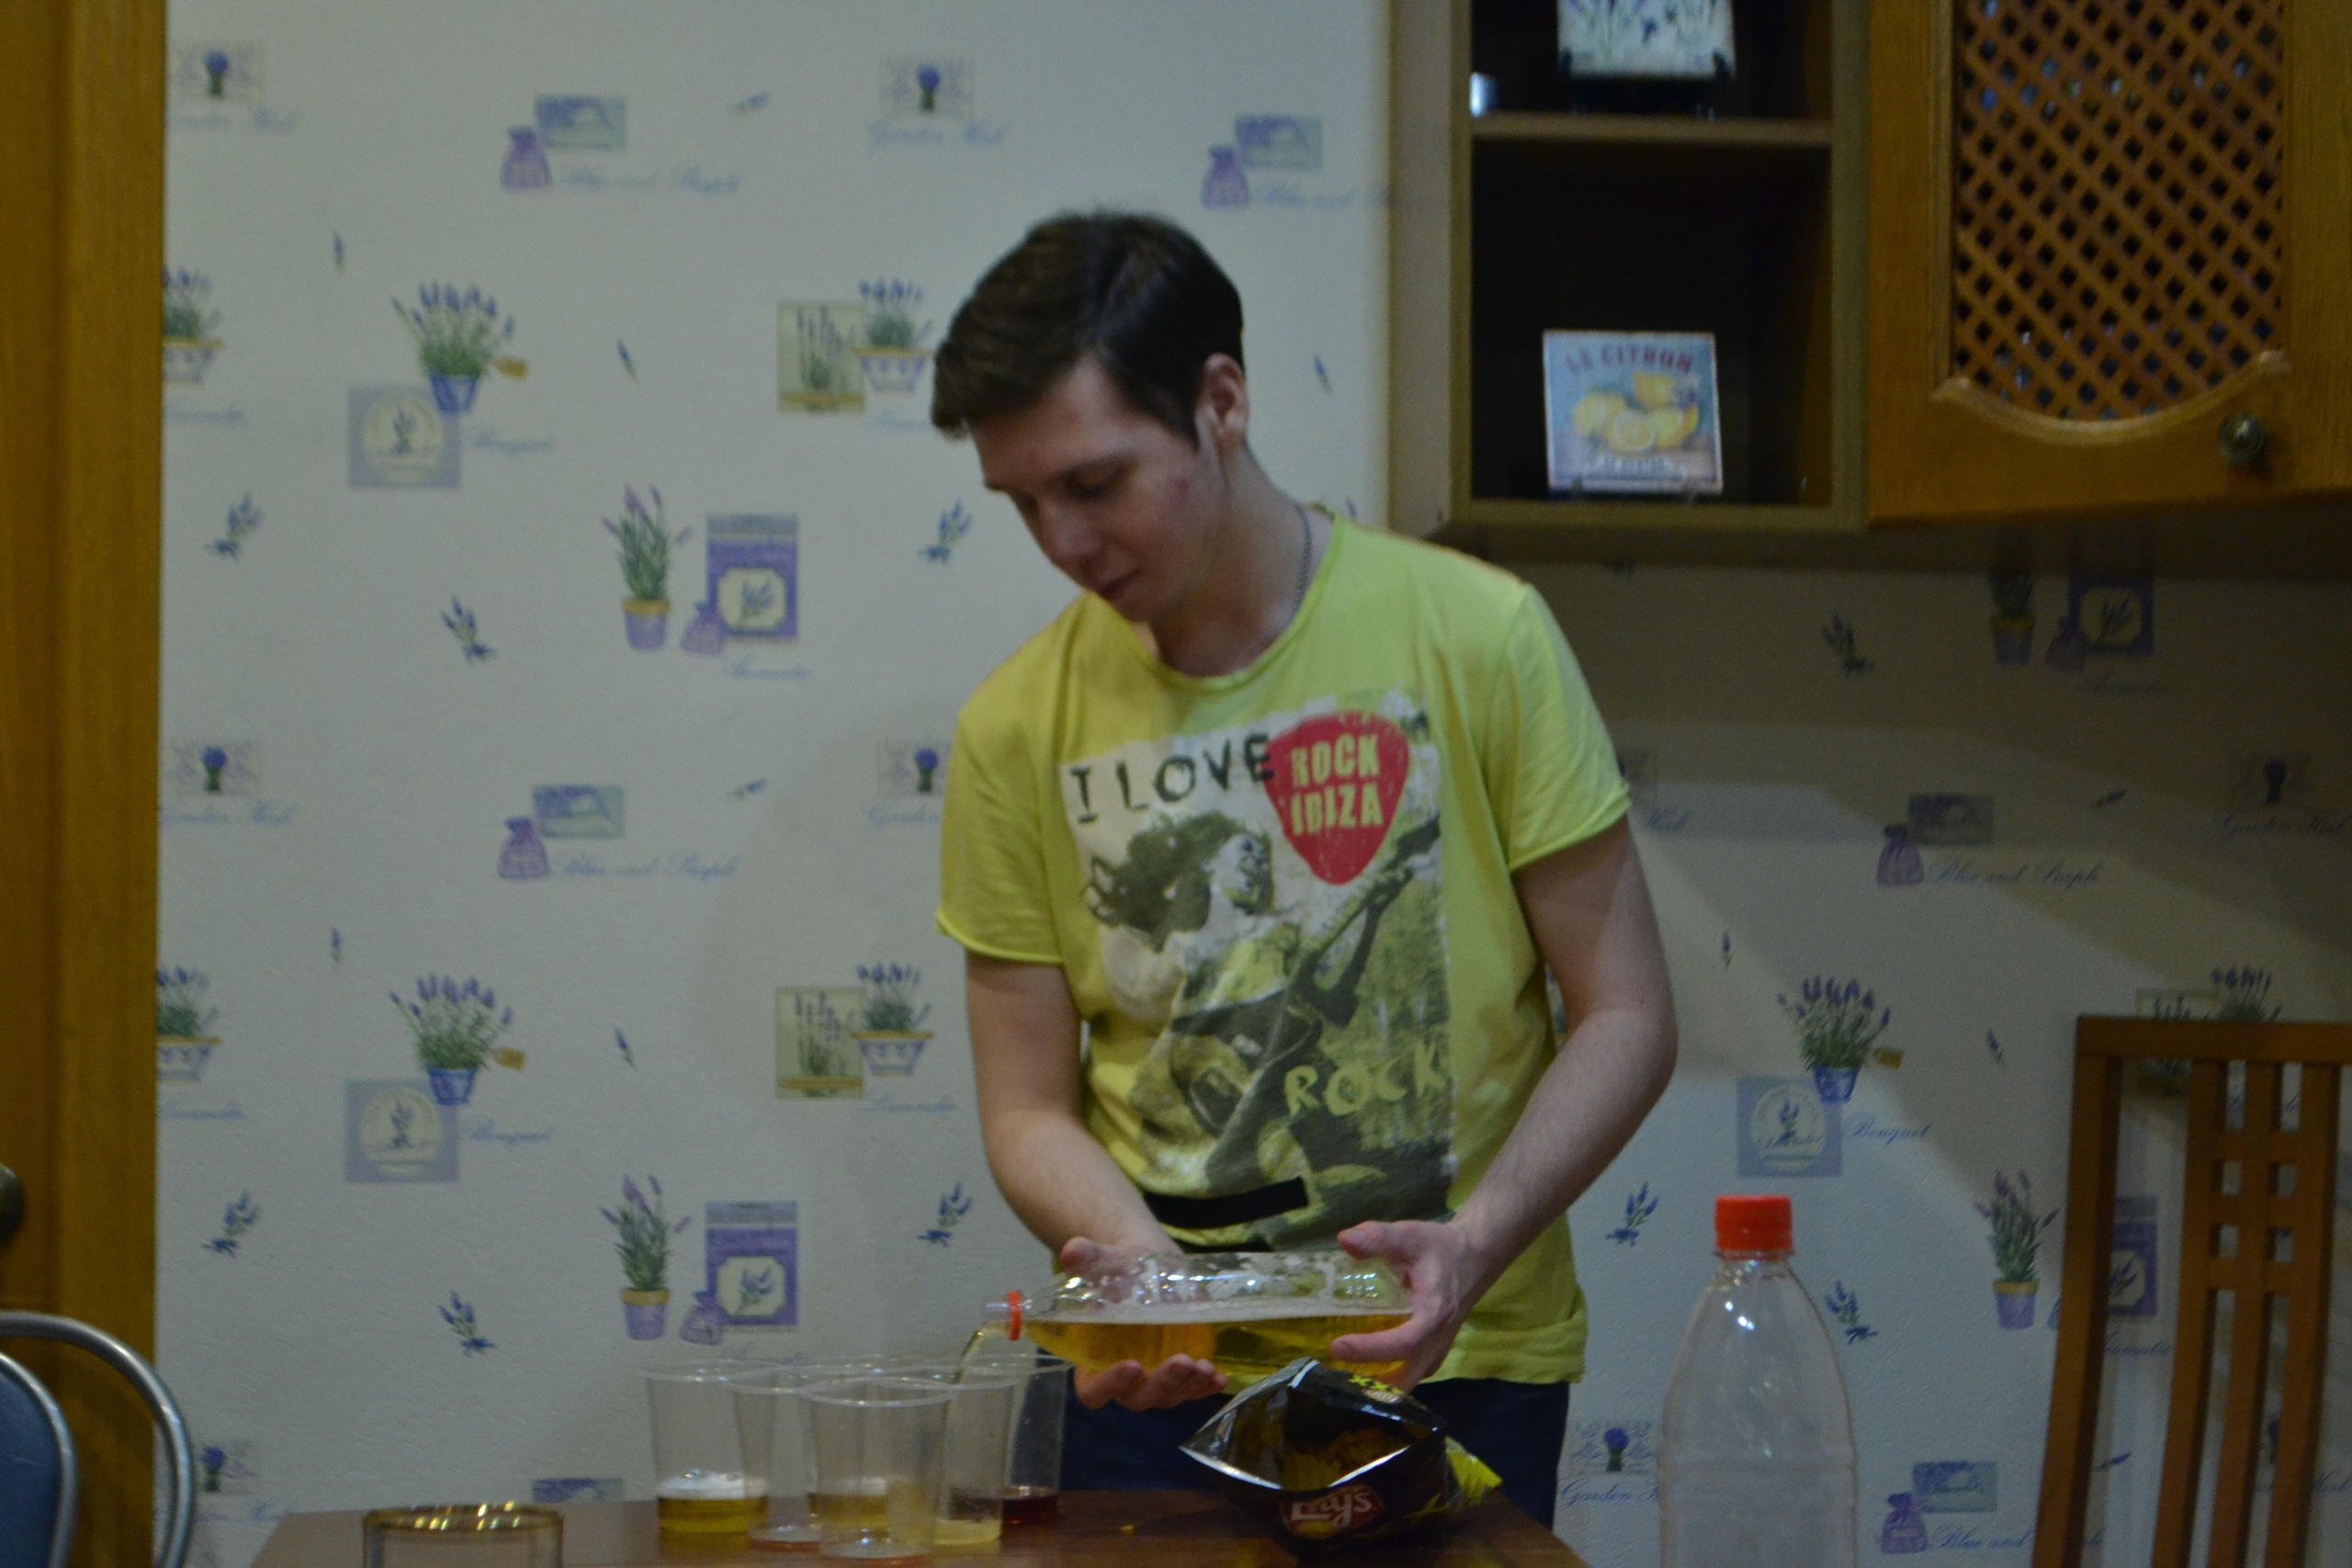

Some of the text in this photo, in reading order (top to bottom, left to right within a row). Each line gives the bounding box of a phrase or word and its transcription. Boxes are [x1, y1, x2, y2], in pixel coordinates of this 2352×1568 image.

[1070, 733, 1275, 824] I LOVE
[1290, 733, 1380, 788] ROCK
[1283, 1040, 1447, 1117] ROCK
